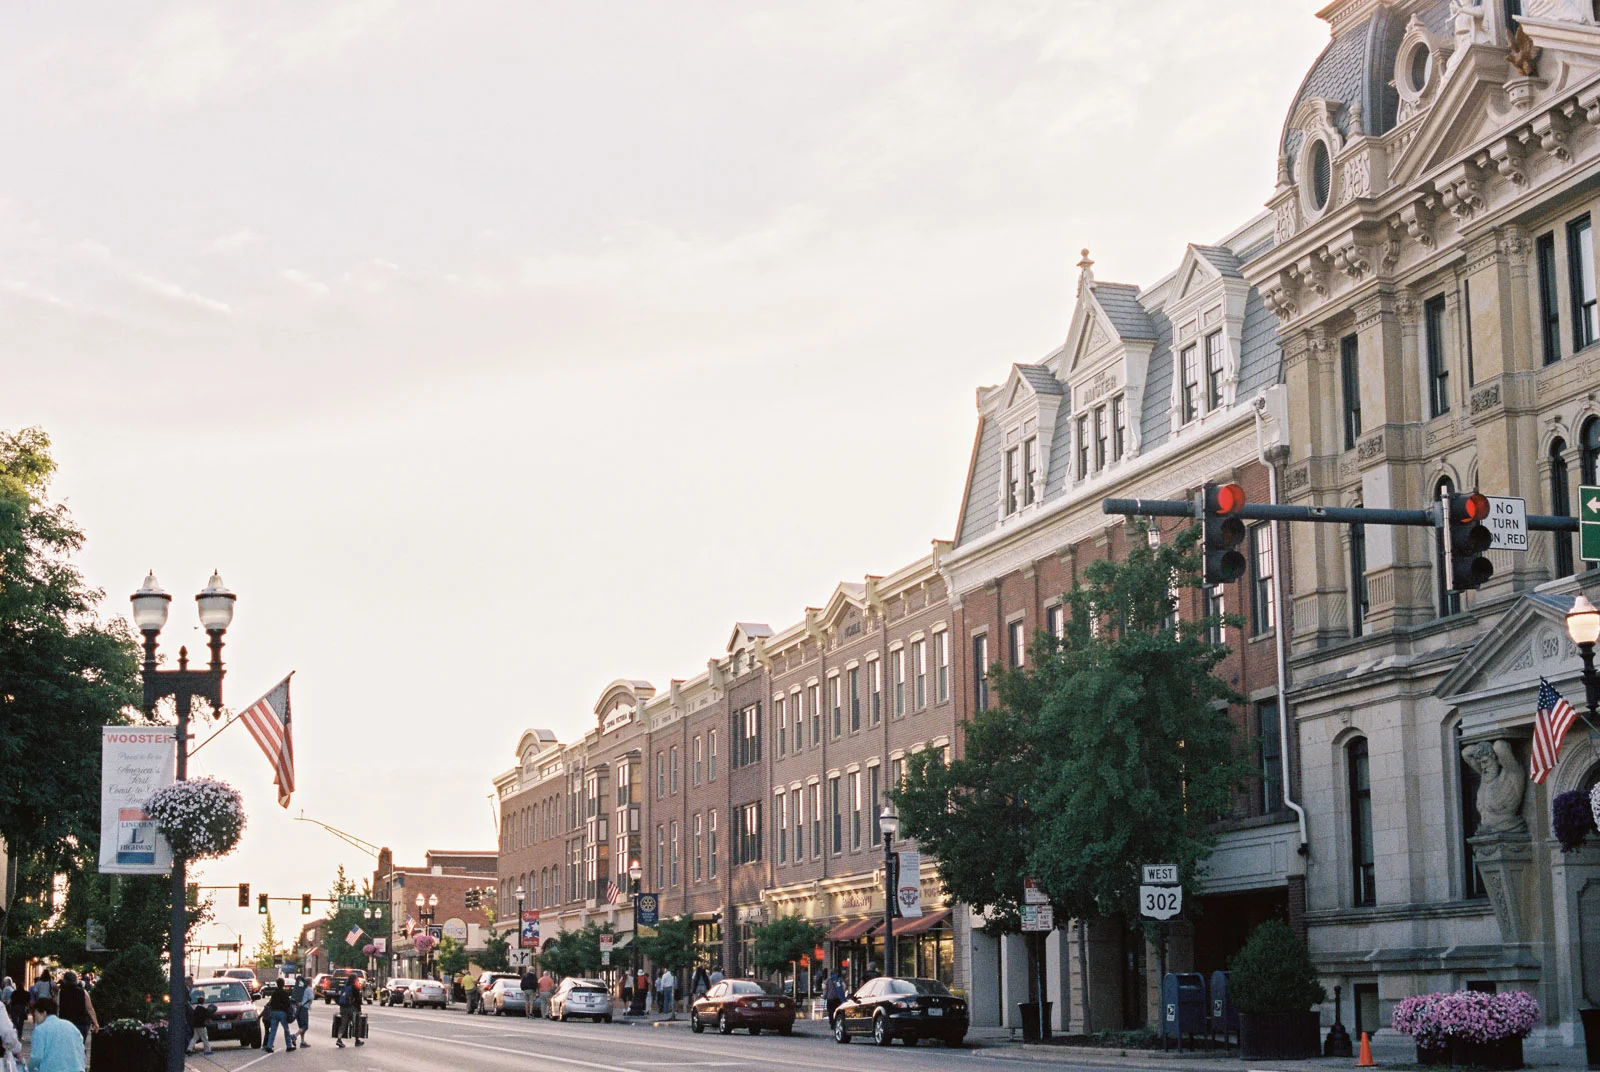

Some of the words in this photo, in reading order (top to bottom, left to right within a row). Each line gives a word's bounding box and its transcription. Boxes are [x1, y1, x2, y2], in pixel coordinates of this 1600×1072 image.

[1496, 503, 1513, 514] NO
[1492, 518, 1519, 529] TURN
[1507, 533, 1526, 545] RED
[107, 734, 172, 743] WOOSTER
[130, 827, 145, 844] L
[1148, 868, 1173, 880] WEST
[1146, 893, 1177, 911] 302
